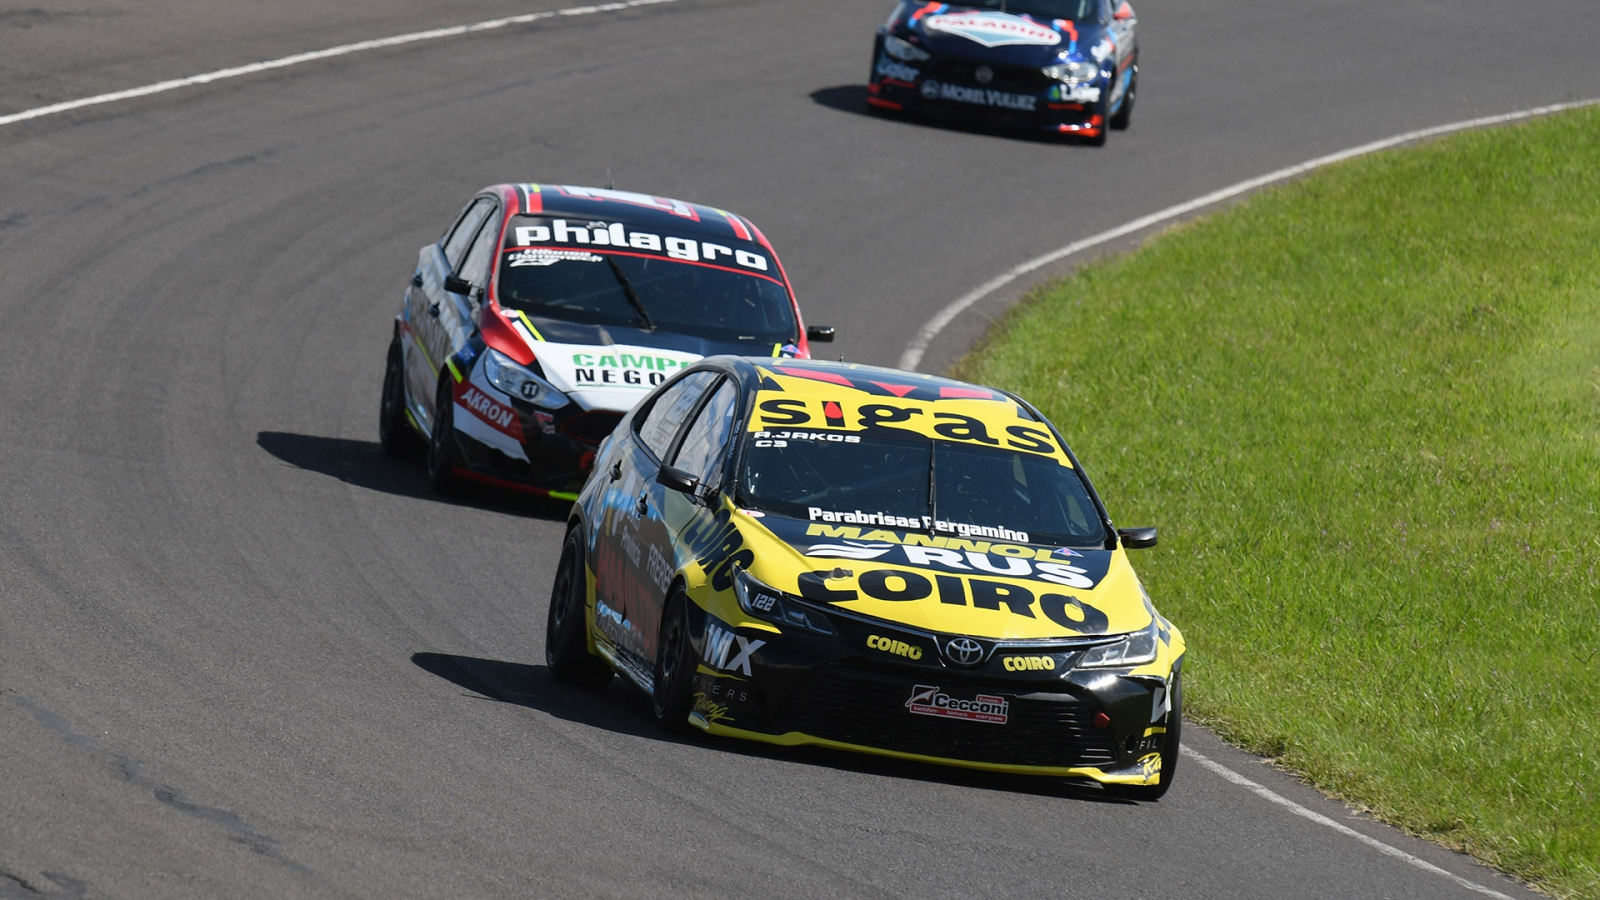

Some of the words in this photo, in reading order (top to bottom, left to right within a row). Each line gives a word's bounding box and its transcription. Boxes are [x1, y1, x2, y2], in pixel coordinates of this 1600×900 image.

[934, 17, 1054, 41] PALADINI
[941, 82, 986, 105] MOREL
[515, 219, 769, 271] philagro
[524, 383, 538, 396] 11
[460, 387, 514, 428] AKRON
[753, 431, 861, 444] A.JAKOS
[759, 399, 1056, 454] sigas
[755, 440, 788, 448] C3
[808, 506, 921, 529] Parabrisas
[805, 523, 1071, 565] MANNOL
[901, 544, 1094, 588] RUS
[751, 594, 776, 612] 122
[797, 569, 1110, 634] COIRO
[866, 633, 923, 661] COIRO
[1002, 656, 1056, 672] COIRO
[934, 694, 1008, 715] Cecconi
[975, 714, 1003, 722] carpas
